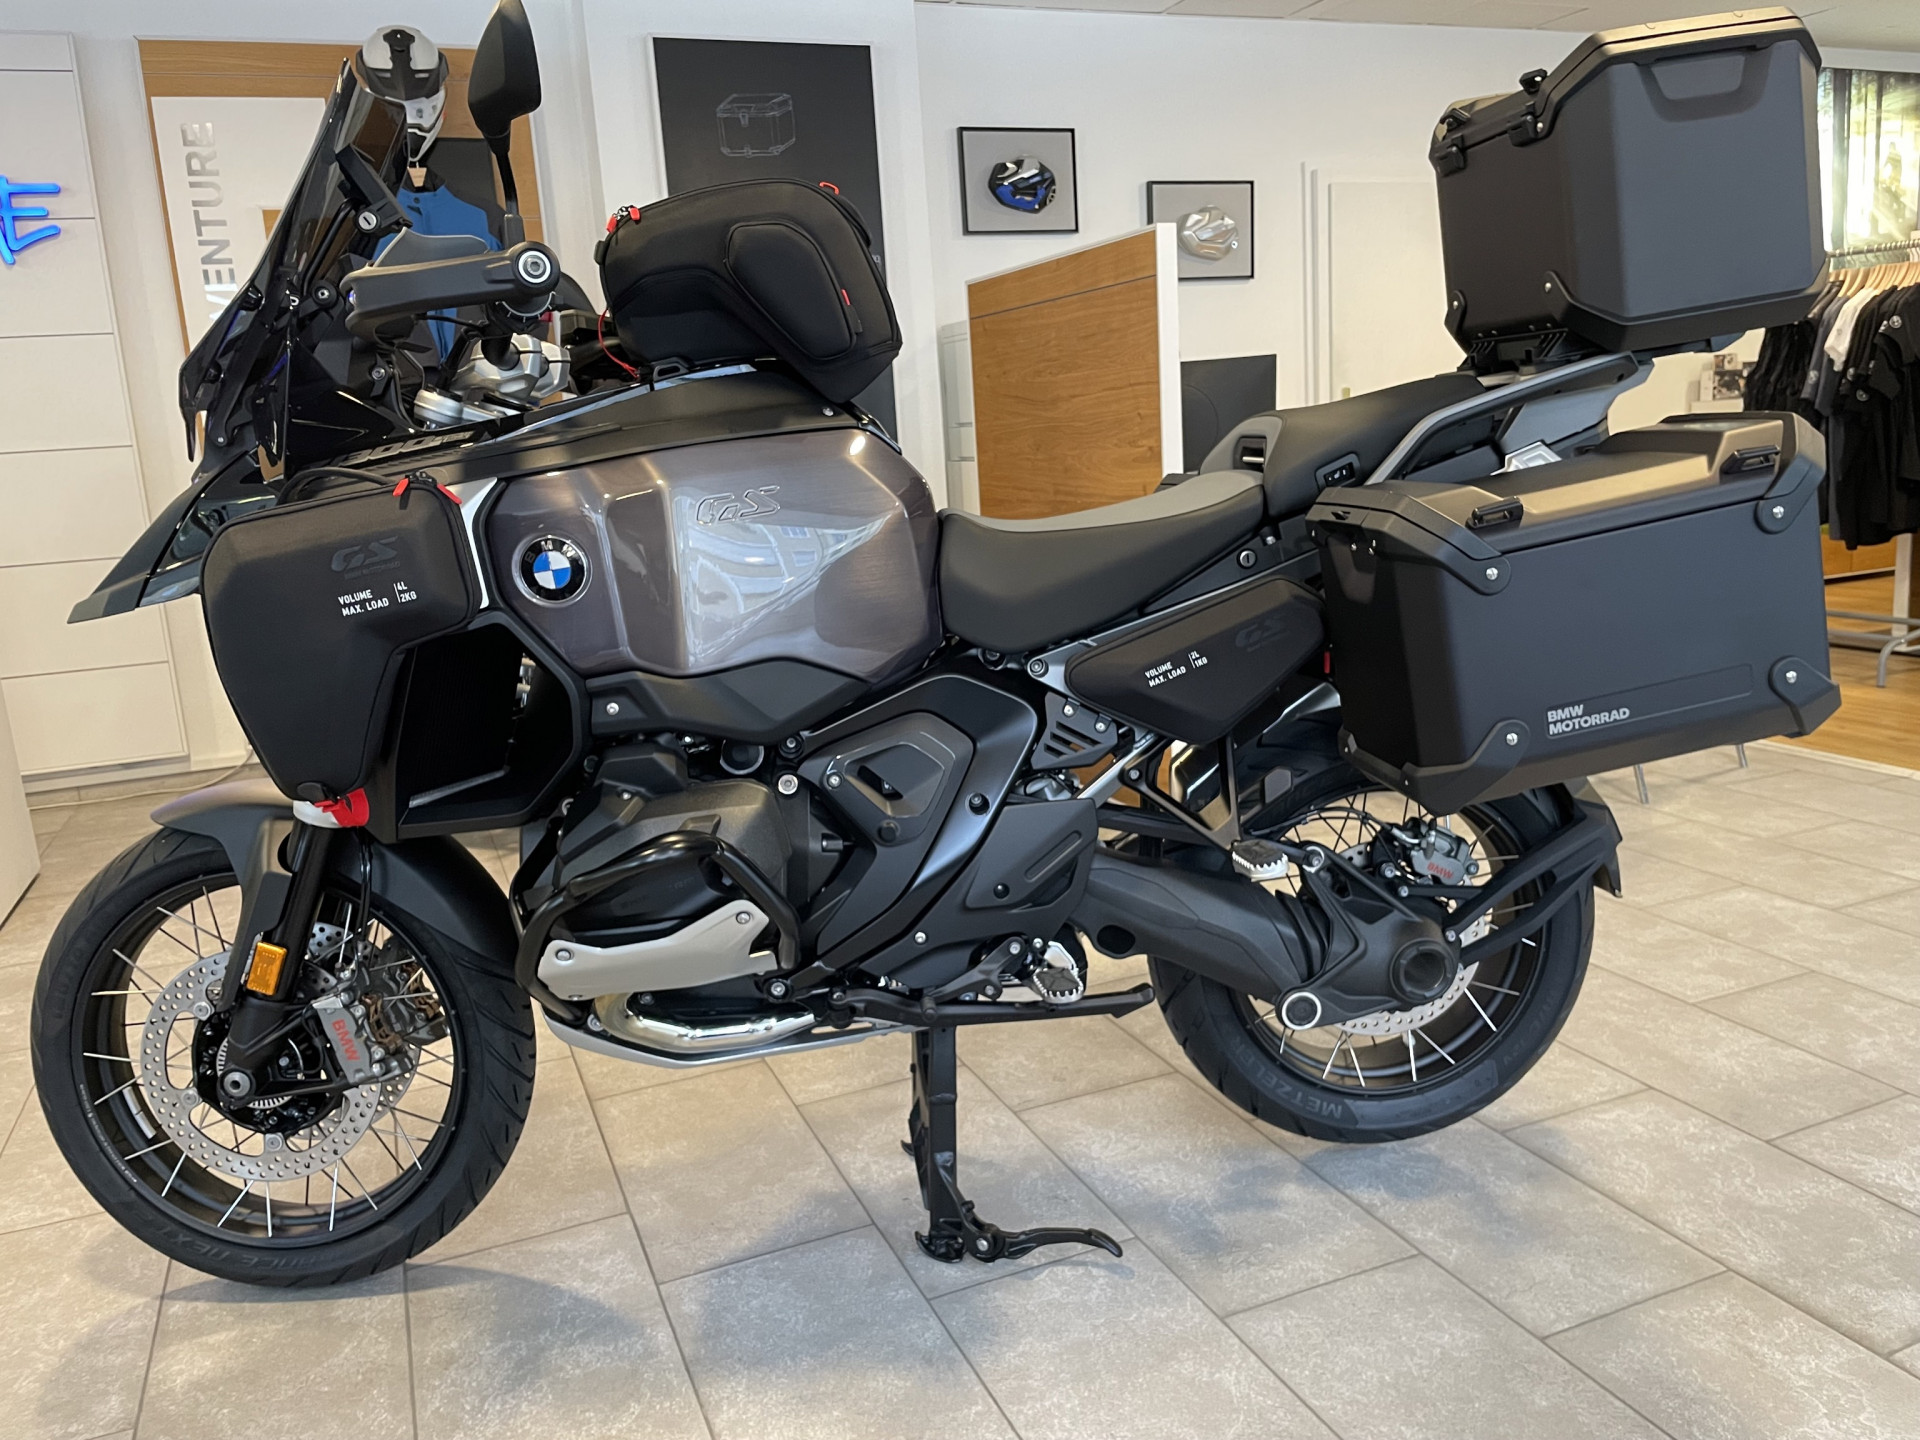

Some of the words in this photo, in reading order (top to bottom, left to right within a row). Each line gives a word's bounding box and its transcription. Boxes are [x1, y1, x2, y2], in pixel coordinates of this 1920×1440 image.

[696, 485, 781, 526] GS
[331, 535, 399, 573] GS
[338, 589, 373, 605] VOLUME
[397, 581, 408, 591] 4L
[341, 604, 365, 617] MAX.
[365, 597, 389, 611] LOAD
[400, 591, 417, 603] 2KG
[1145, 661, 1172, 679] VOLUME
[1190, 650, 1200, 660] 2L
[1148, 675, 1167, 688] MAX.
[1167, 666, 1187, 680] LOAD
[1547, 704, 1584, 722] BMW
[1548, 707, 1630, 736] MOTORRAD
[1427, 861, 1455, 879] BMW
[331, 1019, 362, 1061] BMW
